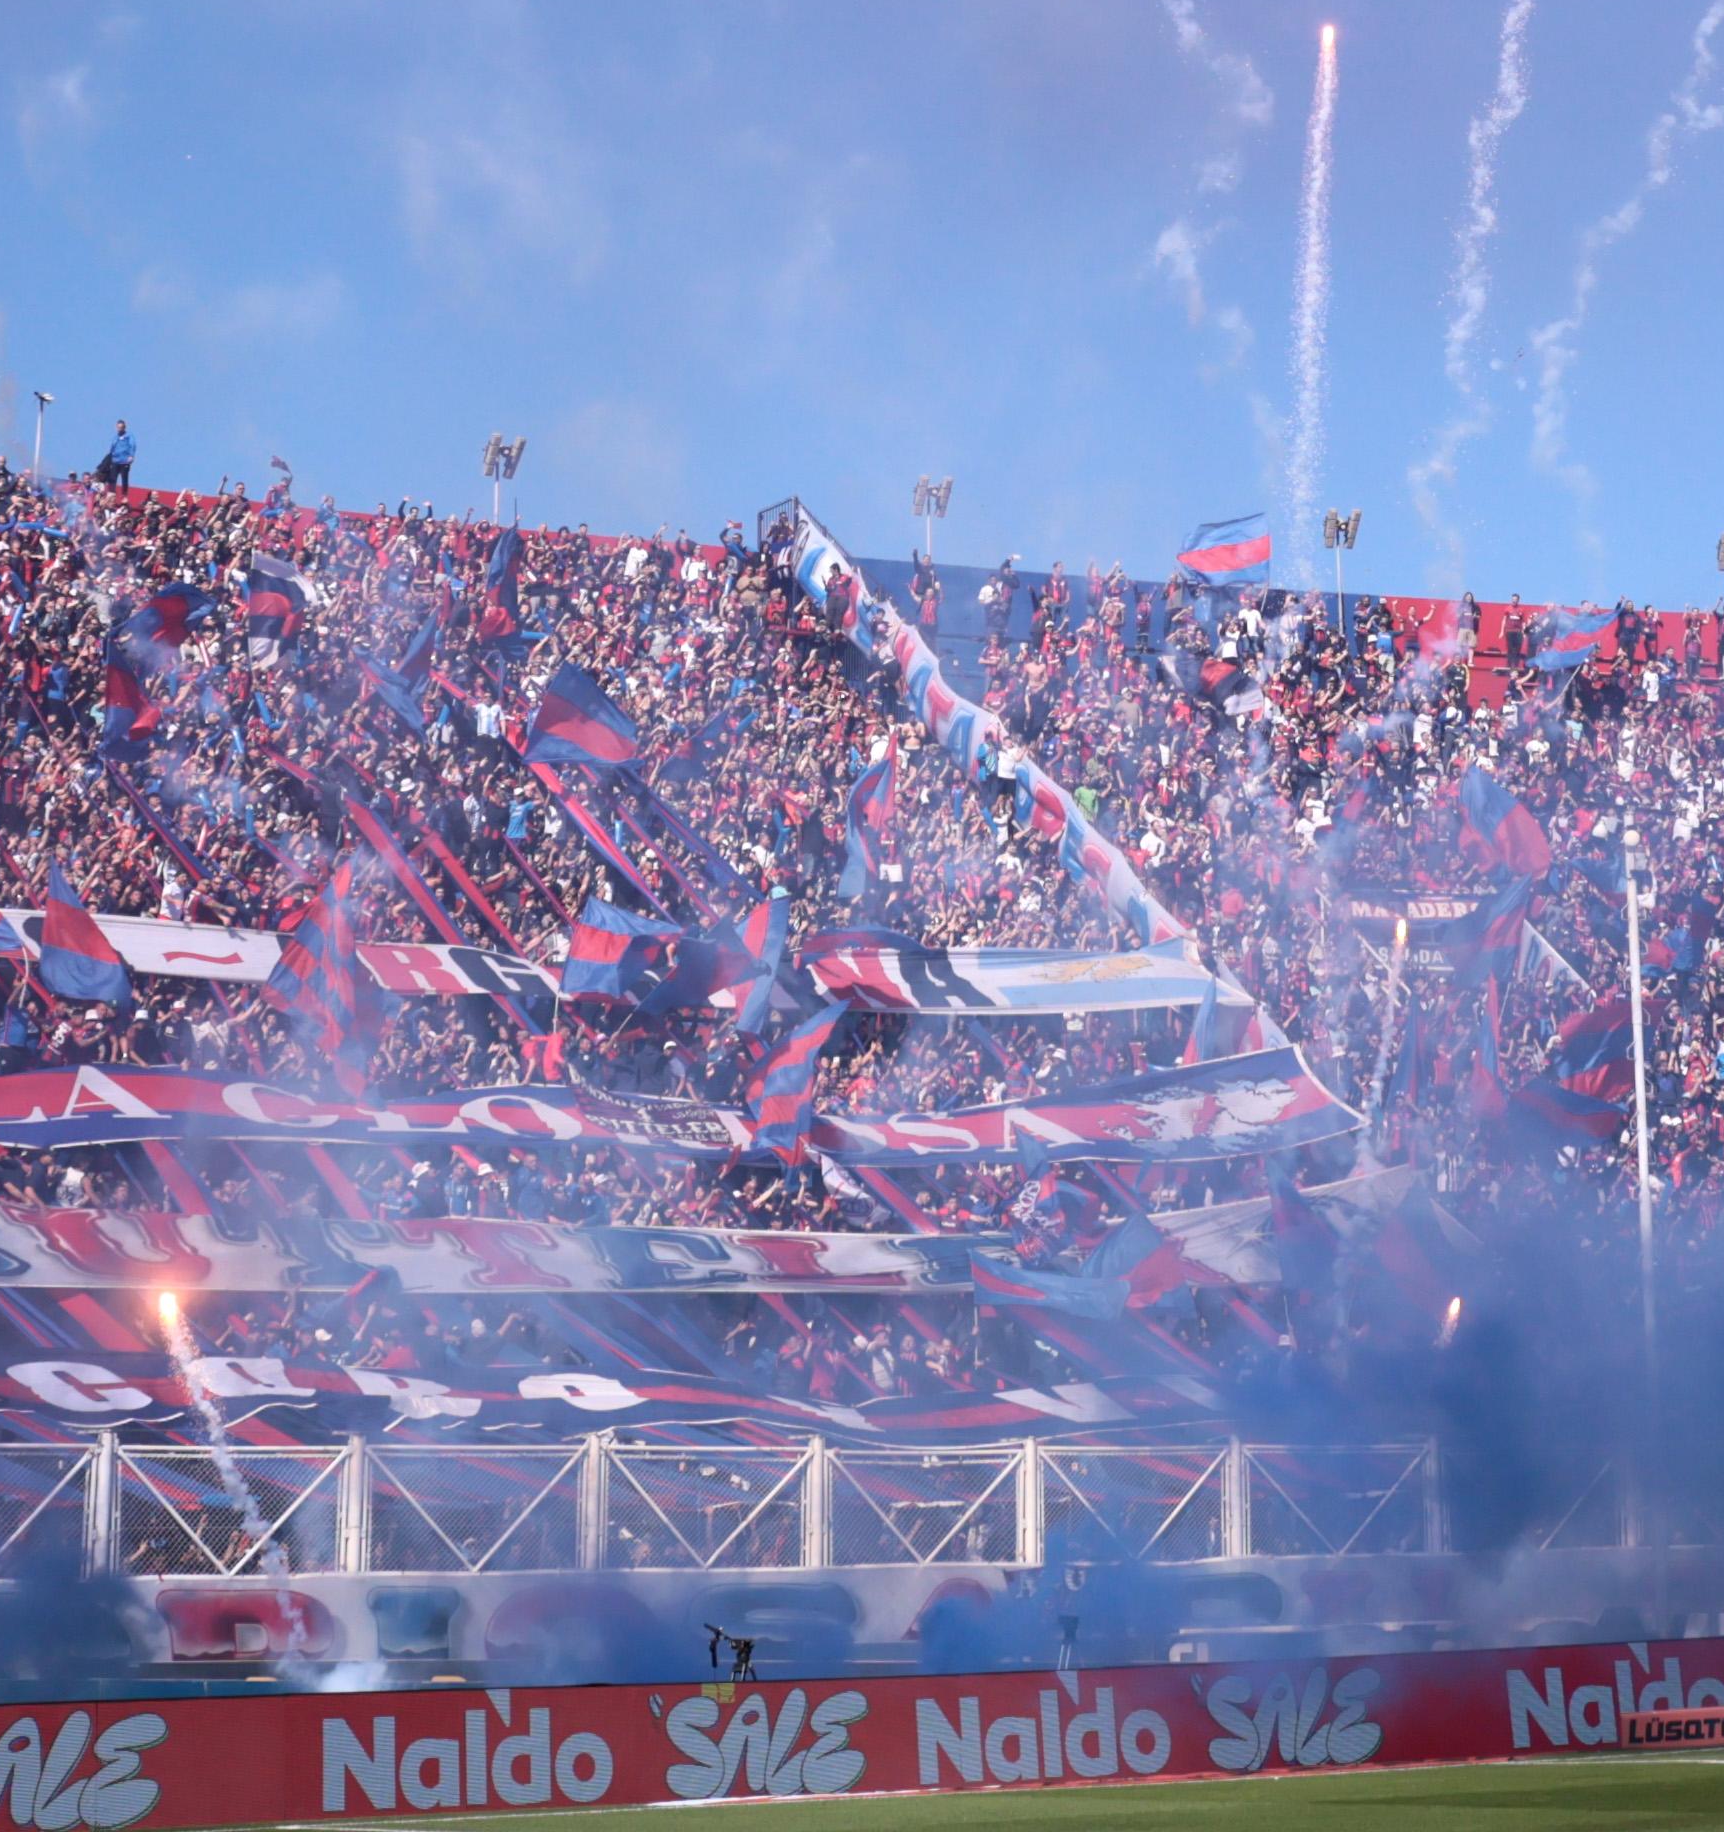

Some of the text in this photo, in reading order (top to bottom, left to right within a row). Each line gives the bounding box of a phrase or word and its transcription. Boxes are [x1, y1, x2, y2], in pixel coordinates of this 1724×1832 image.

[1350, 900, 1479, 919] MAADER
[1378, 946, 1445, 965] SIDA
[322, 1689, 614, 1813] Naldo
[660, 1688, 869, 1802] SALE
[915, 1670, 1172, 1786] Naldo
[1201, 1666, 1383, 1772] SALE
